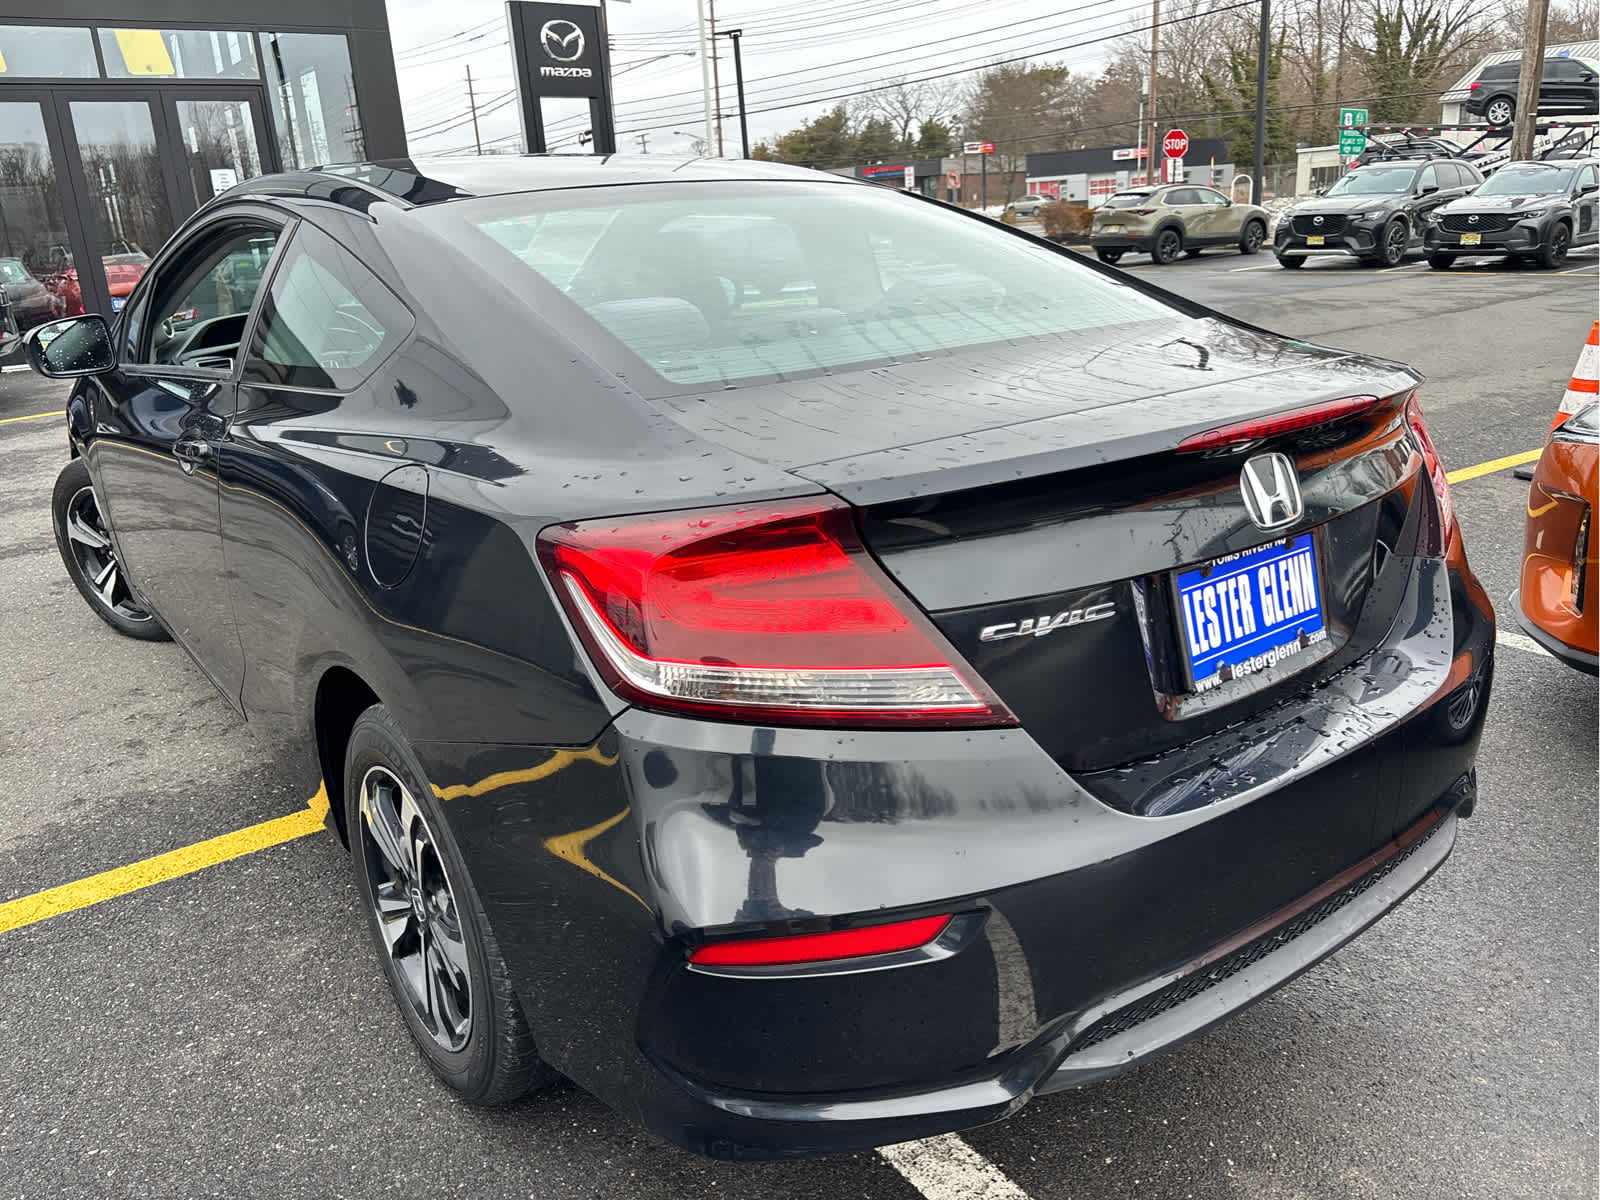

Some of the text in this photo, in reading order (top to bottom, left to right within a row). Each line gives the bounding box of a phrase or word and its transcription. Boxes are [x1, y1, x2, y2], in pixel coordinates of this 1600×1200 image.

[1165, 138, 1186, 150] STOP
[980, 602, 1116, 641] CIVIC
[1182, 574, 1257, 657] LESTER
[1257, 551, 1317, 627] GLENN
